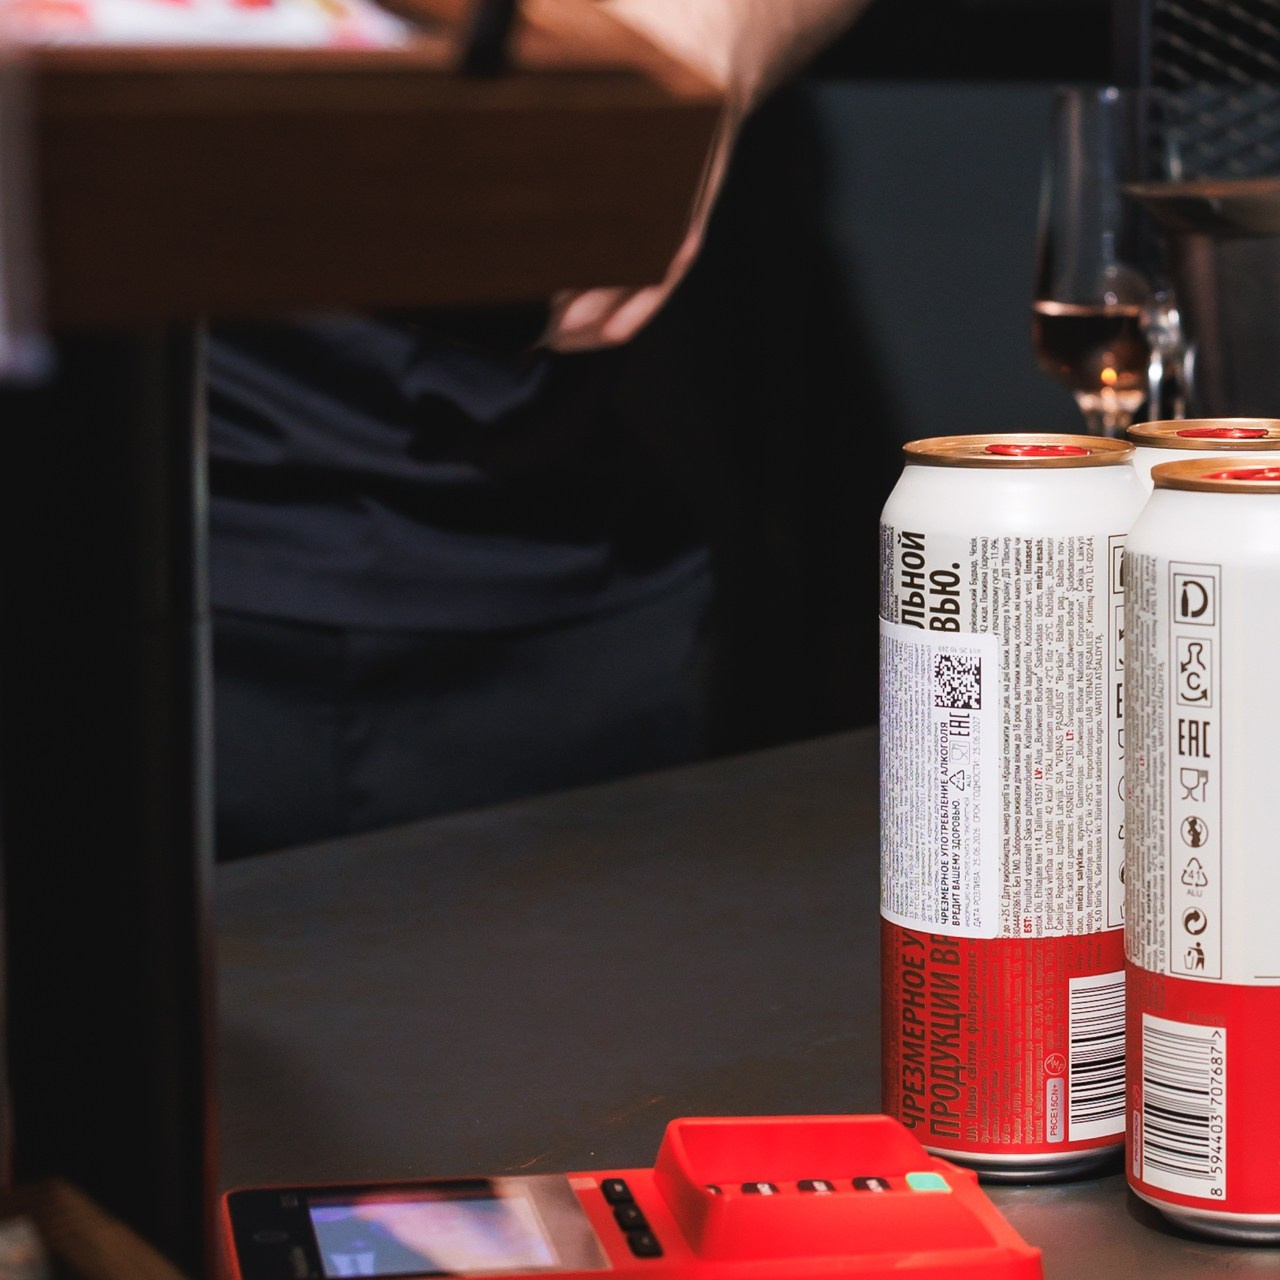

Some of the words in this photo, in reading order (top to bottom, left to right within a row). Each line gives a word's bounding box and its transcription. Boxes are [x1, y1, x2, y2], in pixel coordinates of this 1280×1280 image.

[1024, 690, 1032, 705] hele
[940, 722, 949, 776] АЛКОГОЛЯ
[1035, 748, 1043, 765] Alus
[940, 779, 949, 857] УПОТРЕБЛЕНИЕ
[951, 798, 961, 850] ЗДОРОВЬЮ.
[1024, 819, 1032, 841] Saksa
[1035, 808, 1043, 833] Tallinn
[941, 860, 949, 924] ЧРЕЗМЕРНОЕ
[951, 852, 960, 890] ВАШЕМУ
[952, 893, 961, 926] ВРЕДИТ
[1024, 916, 1032, 933] EST:
[902, 953, 926, 1130] ЧРЕЗМЕРНОЕ
[930, 974, 967, 1138] ПРОДУКЦИИ
[1210, 1046, 1223, 1105] 707687
[1210, 1114, 1223, 1174] 594403
